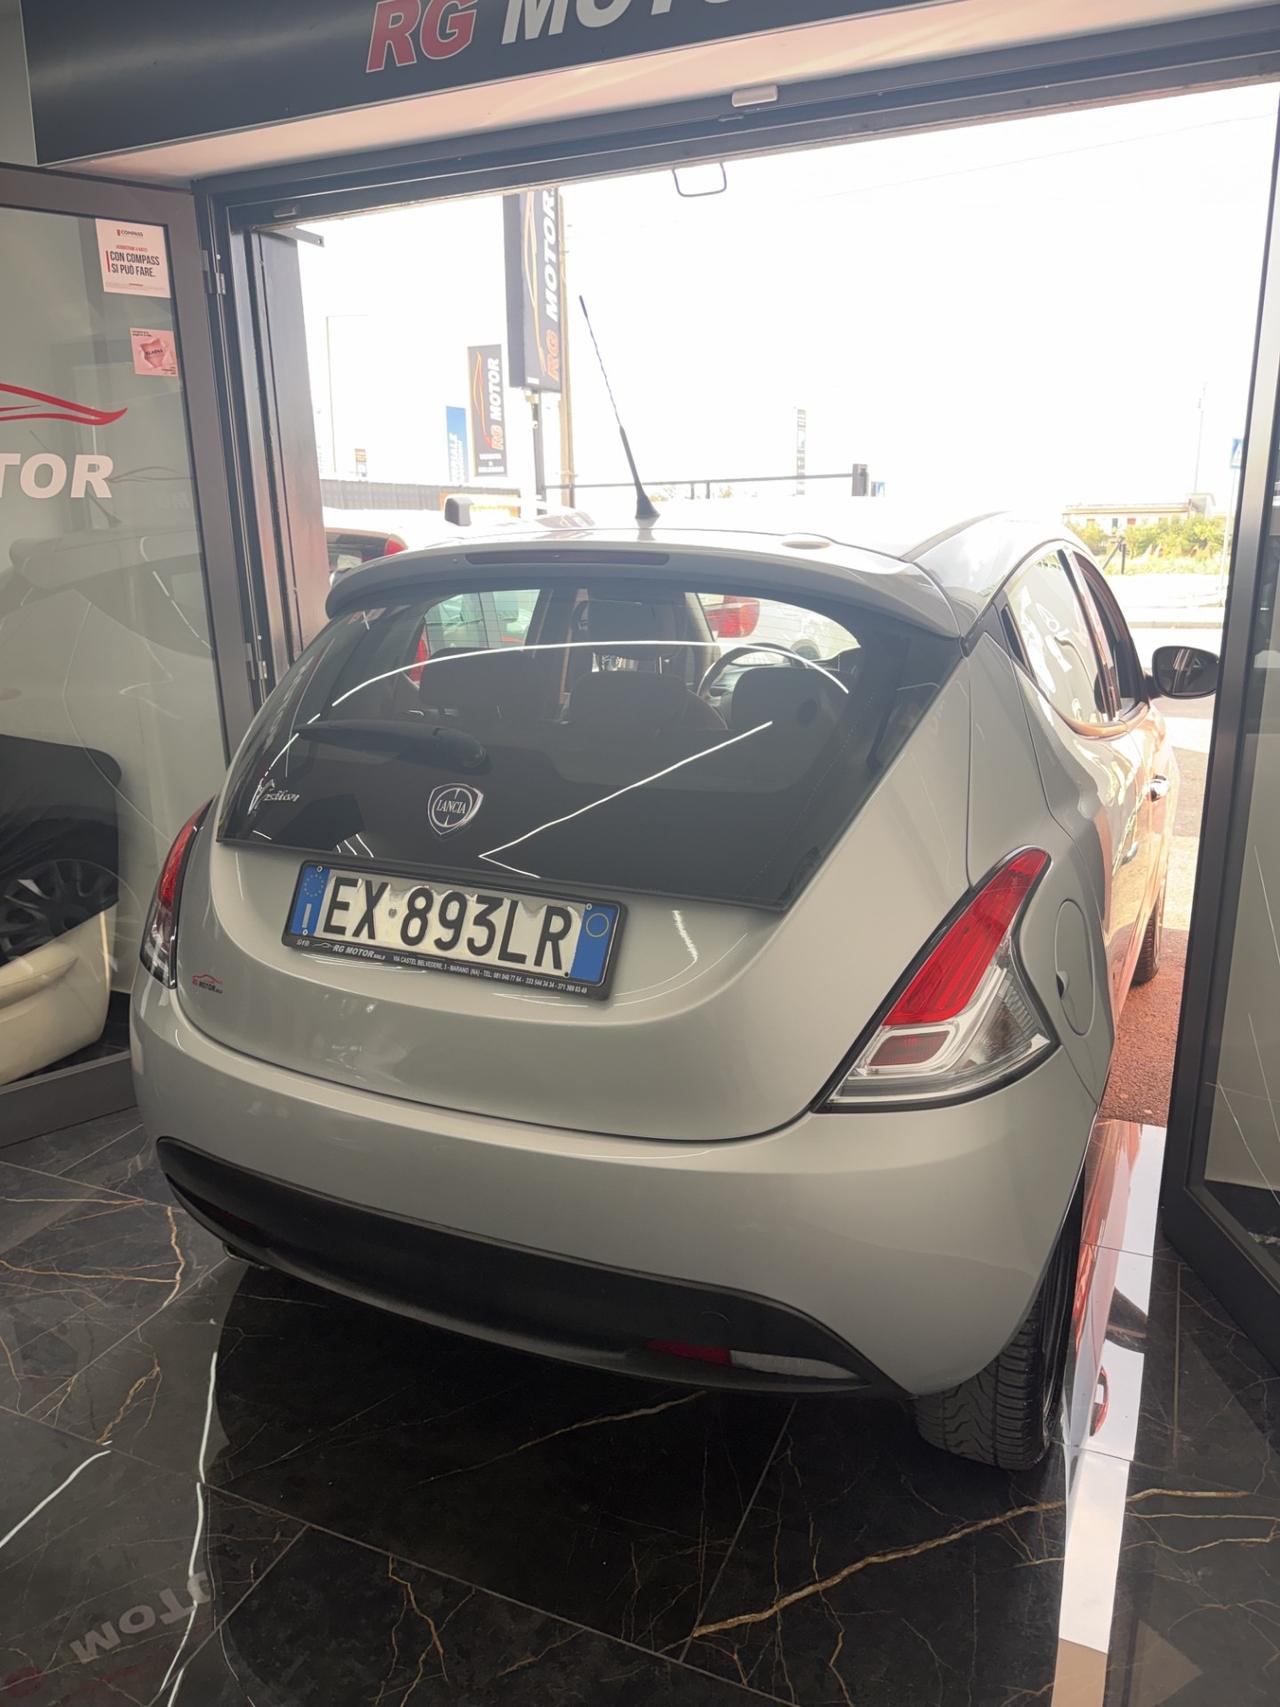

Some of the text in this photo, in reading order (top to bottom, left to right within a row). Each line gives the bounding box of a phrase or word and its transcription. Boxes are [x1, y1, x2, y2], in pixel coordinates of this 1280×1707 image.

[366, 0, 478, 73] RG
[110, 250, 160, 266] CON COMPASS
[111, 263, 119, 274] SI
[487, 357, 503, 421] MOTOR
[436, 799, 467, 814] LANCIA
[323, 876, 389, 940] EX
[400, 887, 572, 970] 893LR
[332, 944, 345, 953] RG
[345, 946, 375, 958] MOTOR
